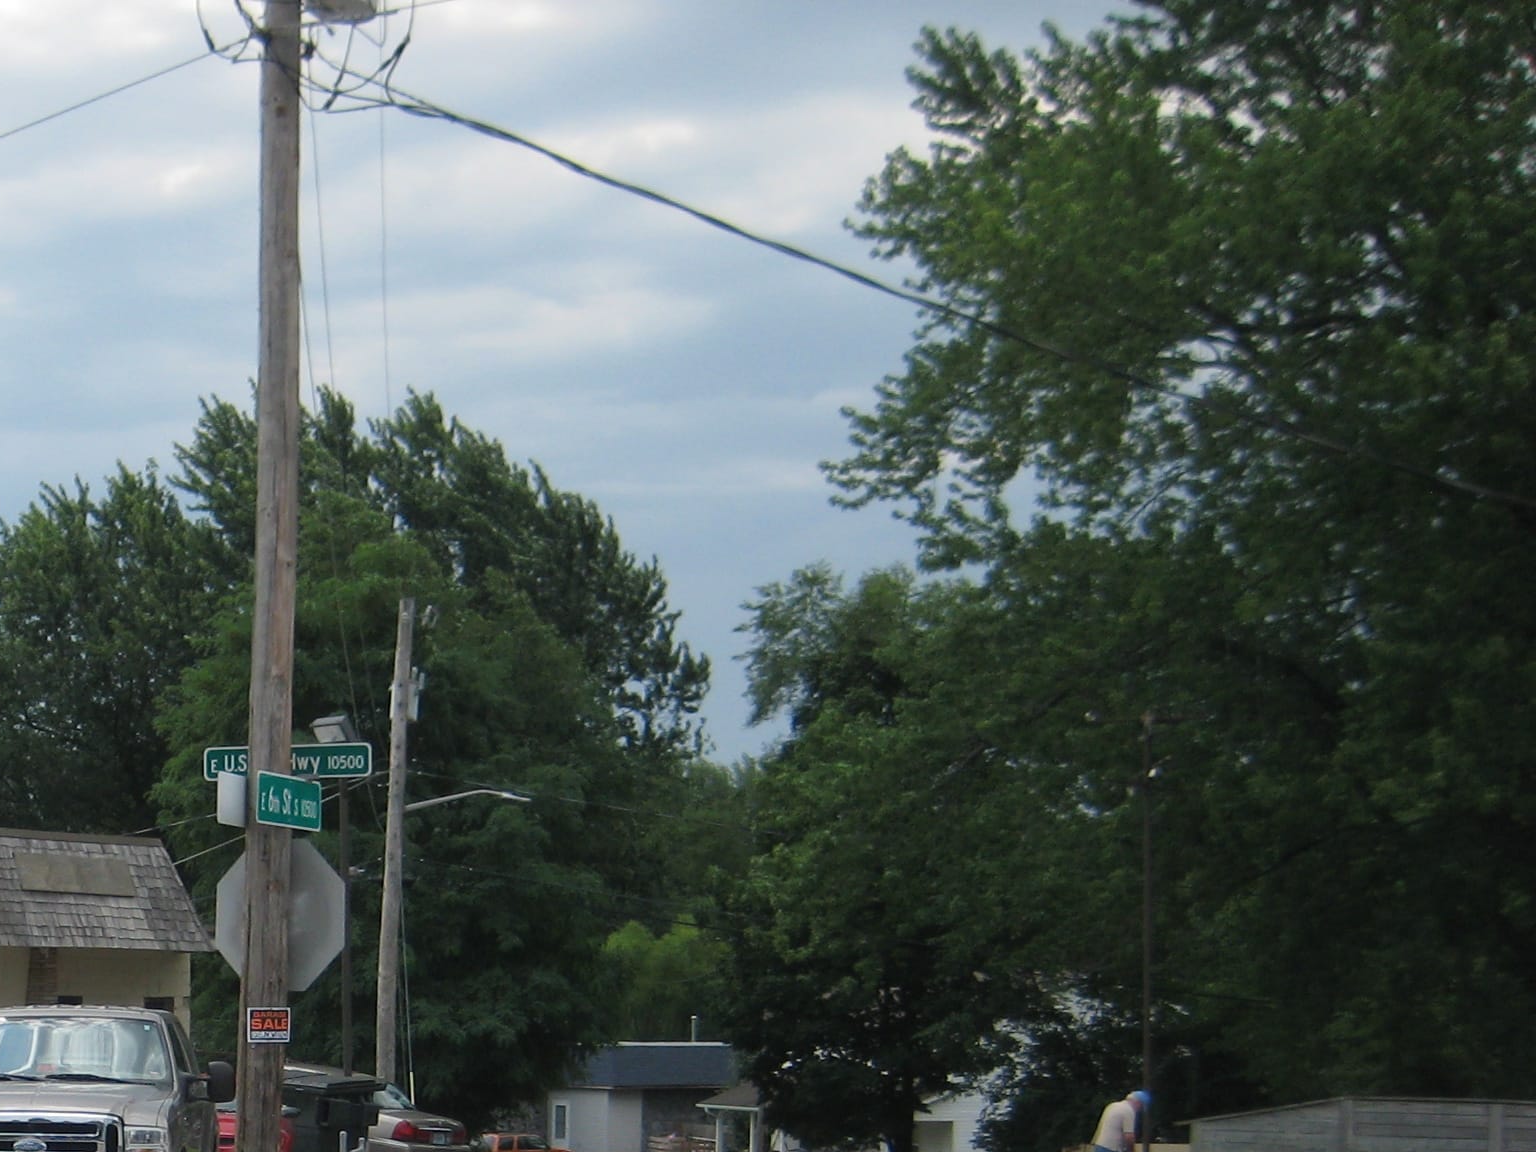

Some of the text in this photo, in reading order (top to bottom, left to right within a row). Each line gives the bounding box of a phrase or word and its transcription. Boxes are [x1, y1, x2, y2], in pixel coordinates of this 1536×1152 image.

[211, 760, 218, 773] E
[327, 755, 364, 770] 10500
[261, 792, 266, 810] E
[251, 1018, 288, 1030] SALE
